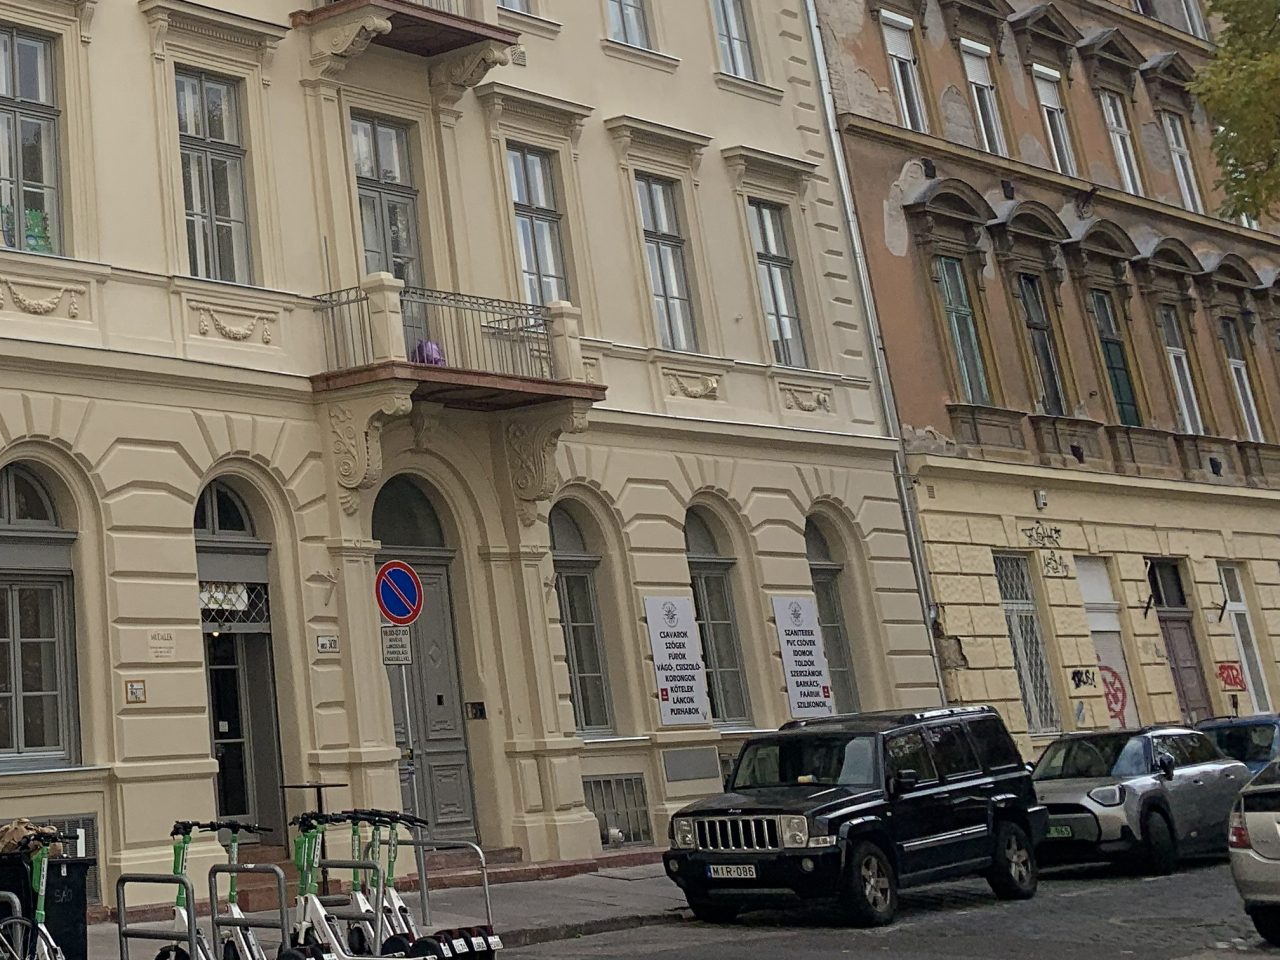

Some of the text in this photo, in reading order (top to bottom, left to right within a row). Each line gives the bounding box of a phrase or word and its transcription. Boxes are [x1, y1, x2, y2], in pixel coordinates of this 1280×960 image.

[793, 649, 814, 657] IDOMOK
[665, 674, 696, 682] KORONGOK
[672, 695, 695, 704] LÁNCOK
